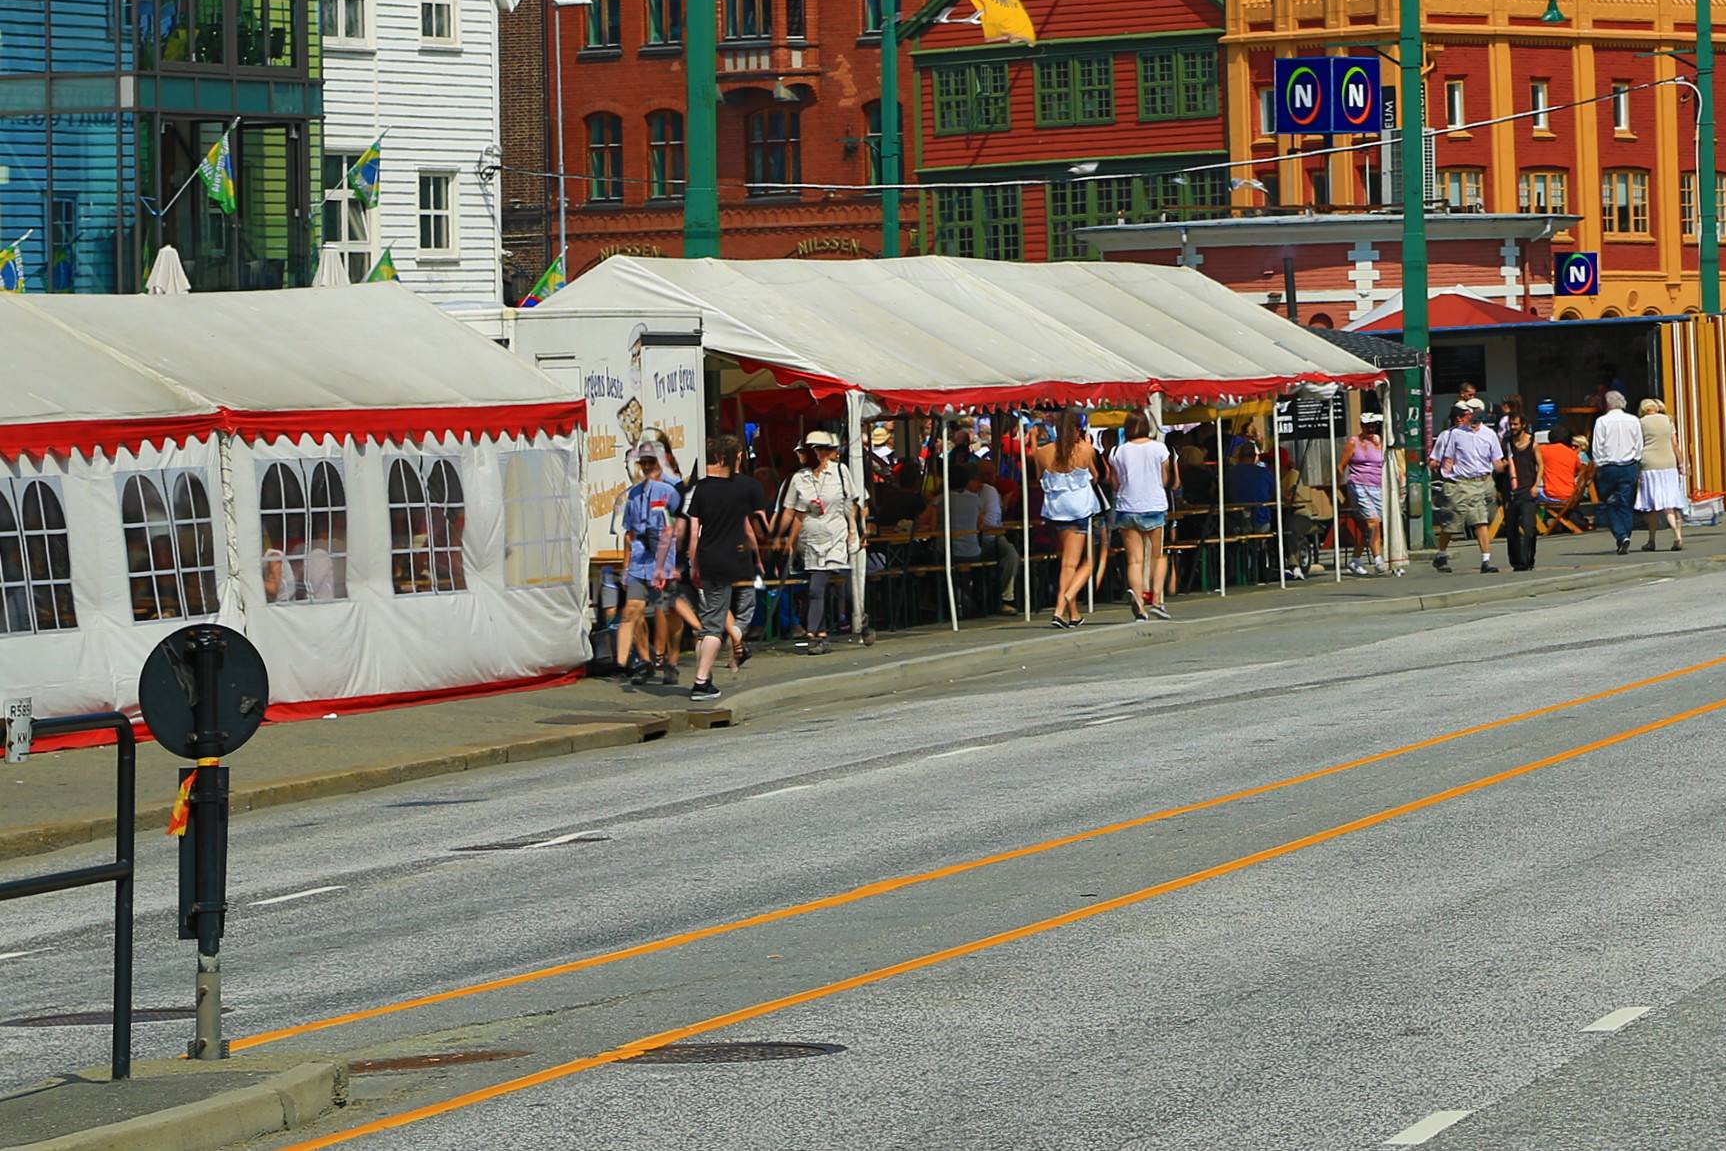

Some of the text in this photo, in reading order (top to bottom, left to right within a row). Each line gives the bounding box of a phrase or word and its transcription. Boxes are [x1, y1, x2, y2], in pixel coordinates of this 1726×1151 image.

[1294, 84, 1313, 108] N
[1348, 83, 1365, 107] N
[1384, 100, 1394, 129] EUM
[797, 237, 861, 255] NILSSEN
[1569, 265, 1586, 283] N
[605, 366, 624, 399] beste
[654, 371, 666, 403] Try
[667, 370, 678, 395] our
